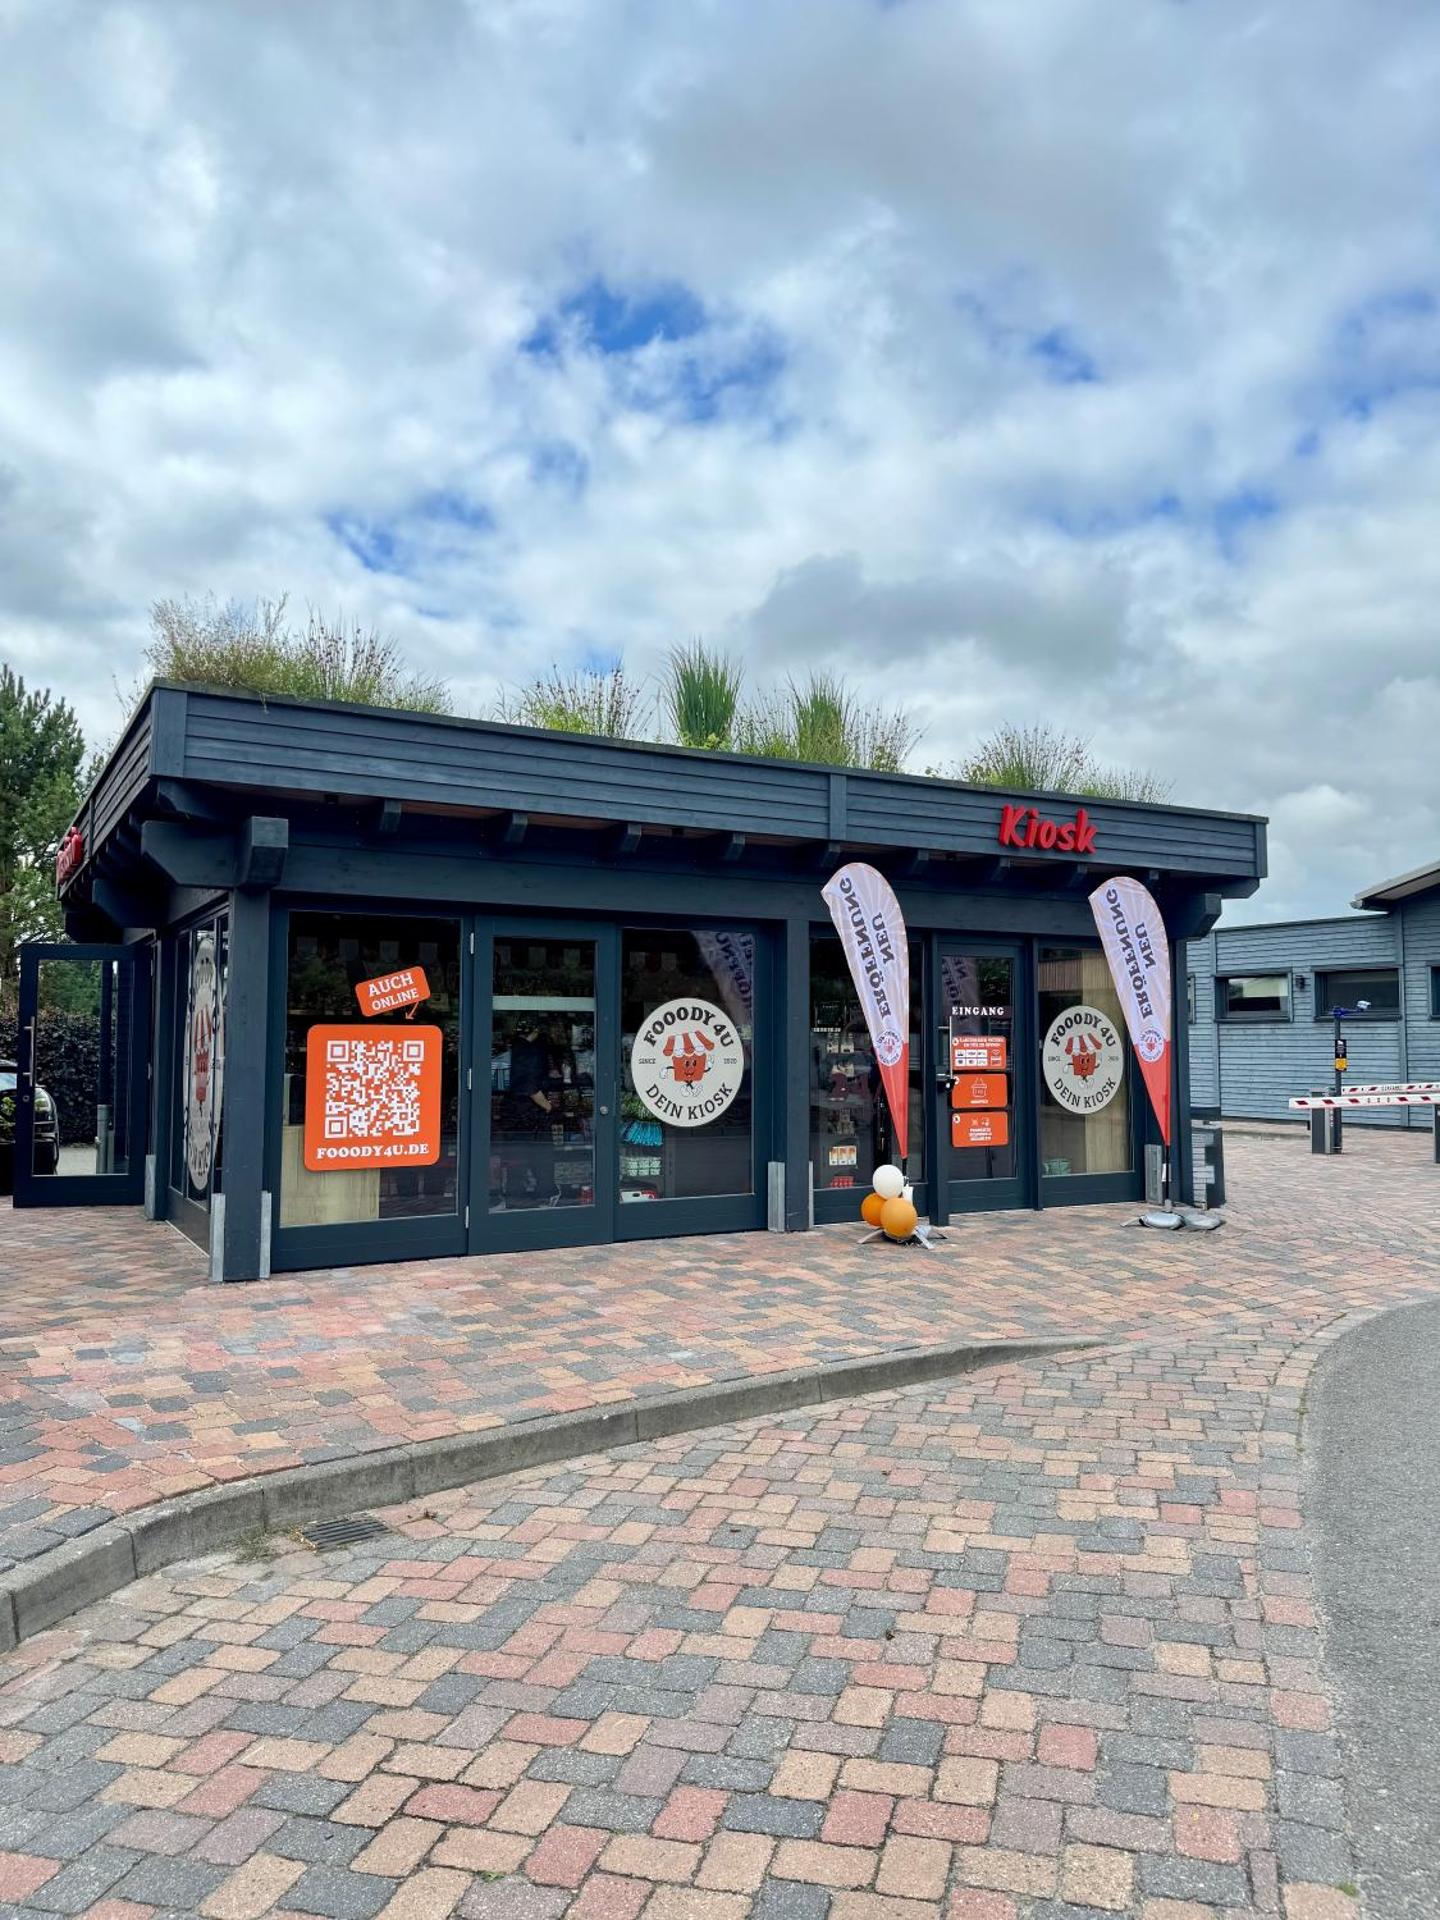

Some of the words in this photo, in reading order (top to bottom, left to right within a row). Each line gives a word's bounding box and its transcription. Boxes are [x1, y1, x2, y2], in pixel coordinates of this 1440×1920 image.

[998, 803, 1098, 855] Kiosk
[368, 972, 414, 997] AUCH
[372, 987, 419, 1011] ONLINE
[643, 1006, 716, 1047] FOOODY
[713, 1023, 734, 1048] 4U
[951, 1006, 1005, 1016] EINGANG
[1050, 1013, 1102, 1047] FOOODY
[1100, 1026, 1116, 1047] 4U
[646, 1083, 683, 1119] DEIN
[688, 1082, 733, 1120] KIOSK
[1053, 1078, 1081, 1107] DEIN
[1084, 1077, 1116, 1109] KIOSK
[316, 1143, 430, 1160] FOOODY4U.DE
